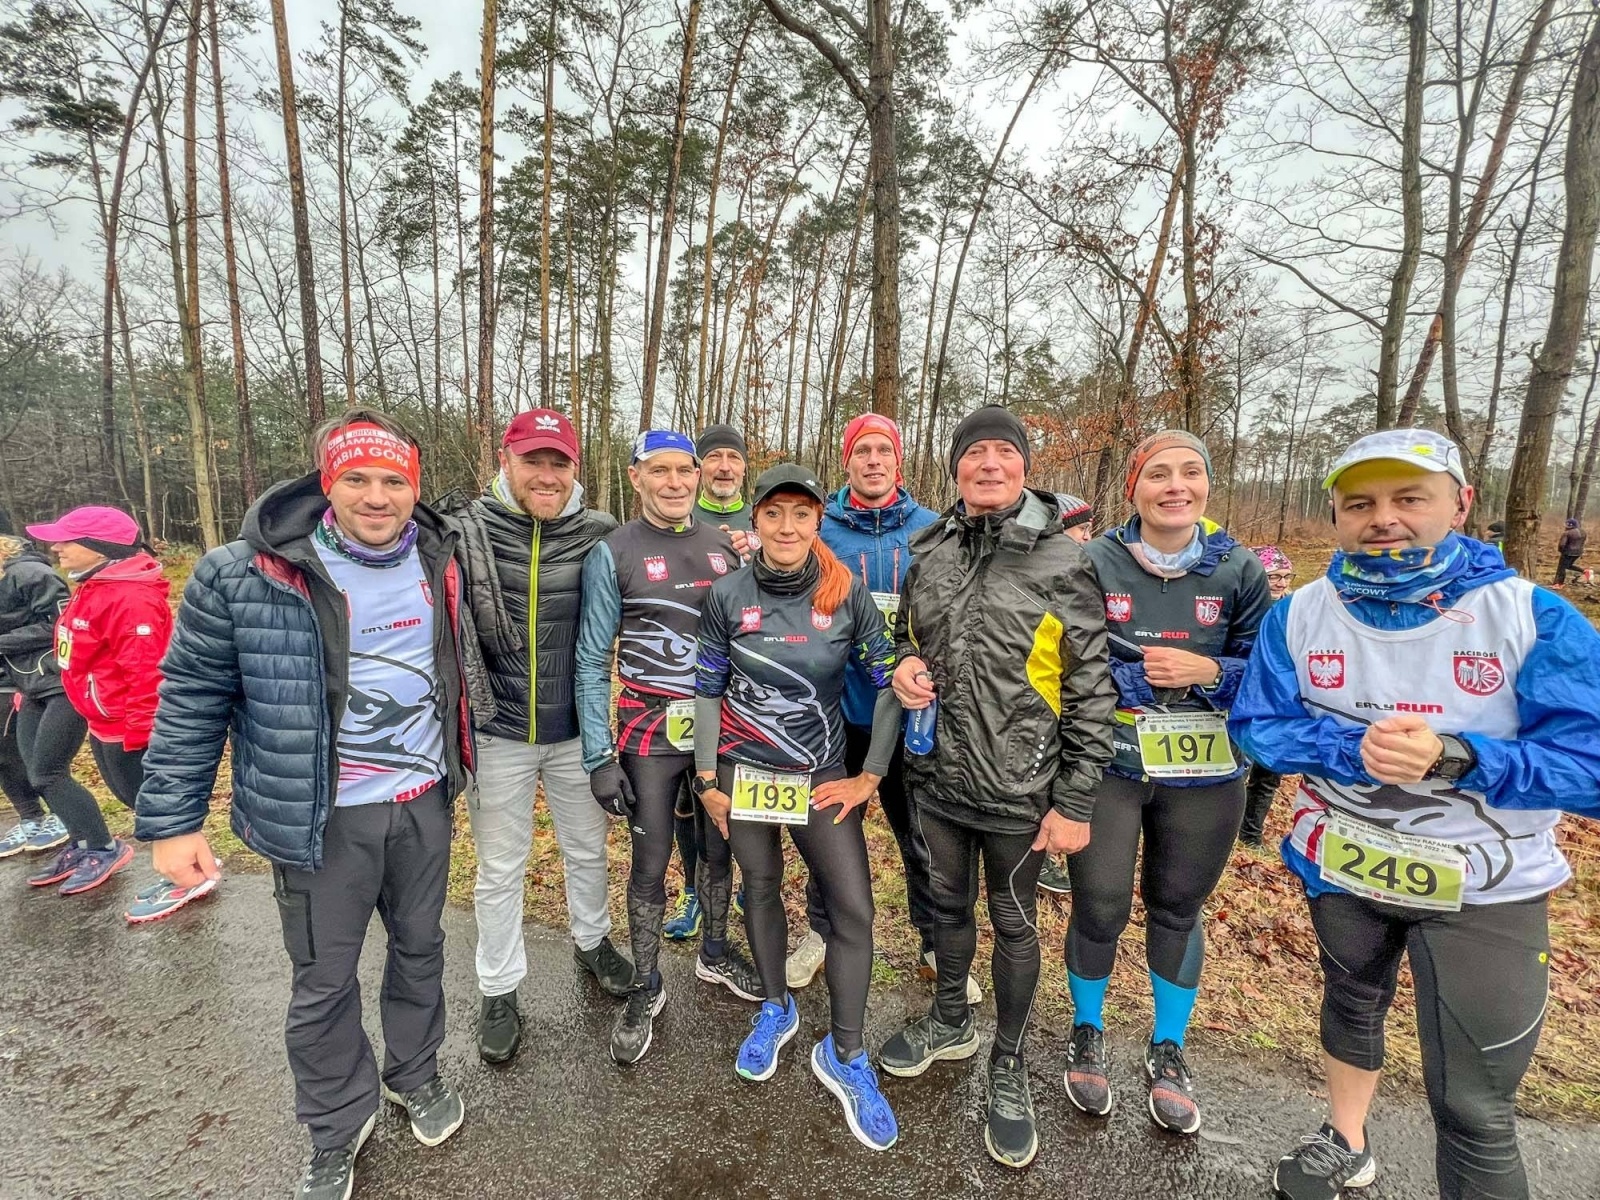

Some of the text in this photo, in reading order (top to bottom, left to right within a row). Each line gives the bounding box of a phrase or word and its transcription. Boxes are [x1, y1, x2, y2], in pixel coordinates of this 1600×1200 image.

[329, 437, 411, 459] ULTRAMARATON
[332, 447, 409, 470] BABIA GÓRA
[1453, 650, 1498, 658] RACIBÓRZ
[680, 717, 694, 740] 2
[1157, 734, 1216, 763] 197
[747, 783, 797, 811] 193
[1339, 843, 1438, 897] 249
